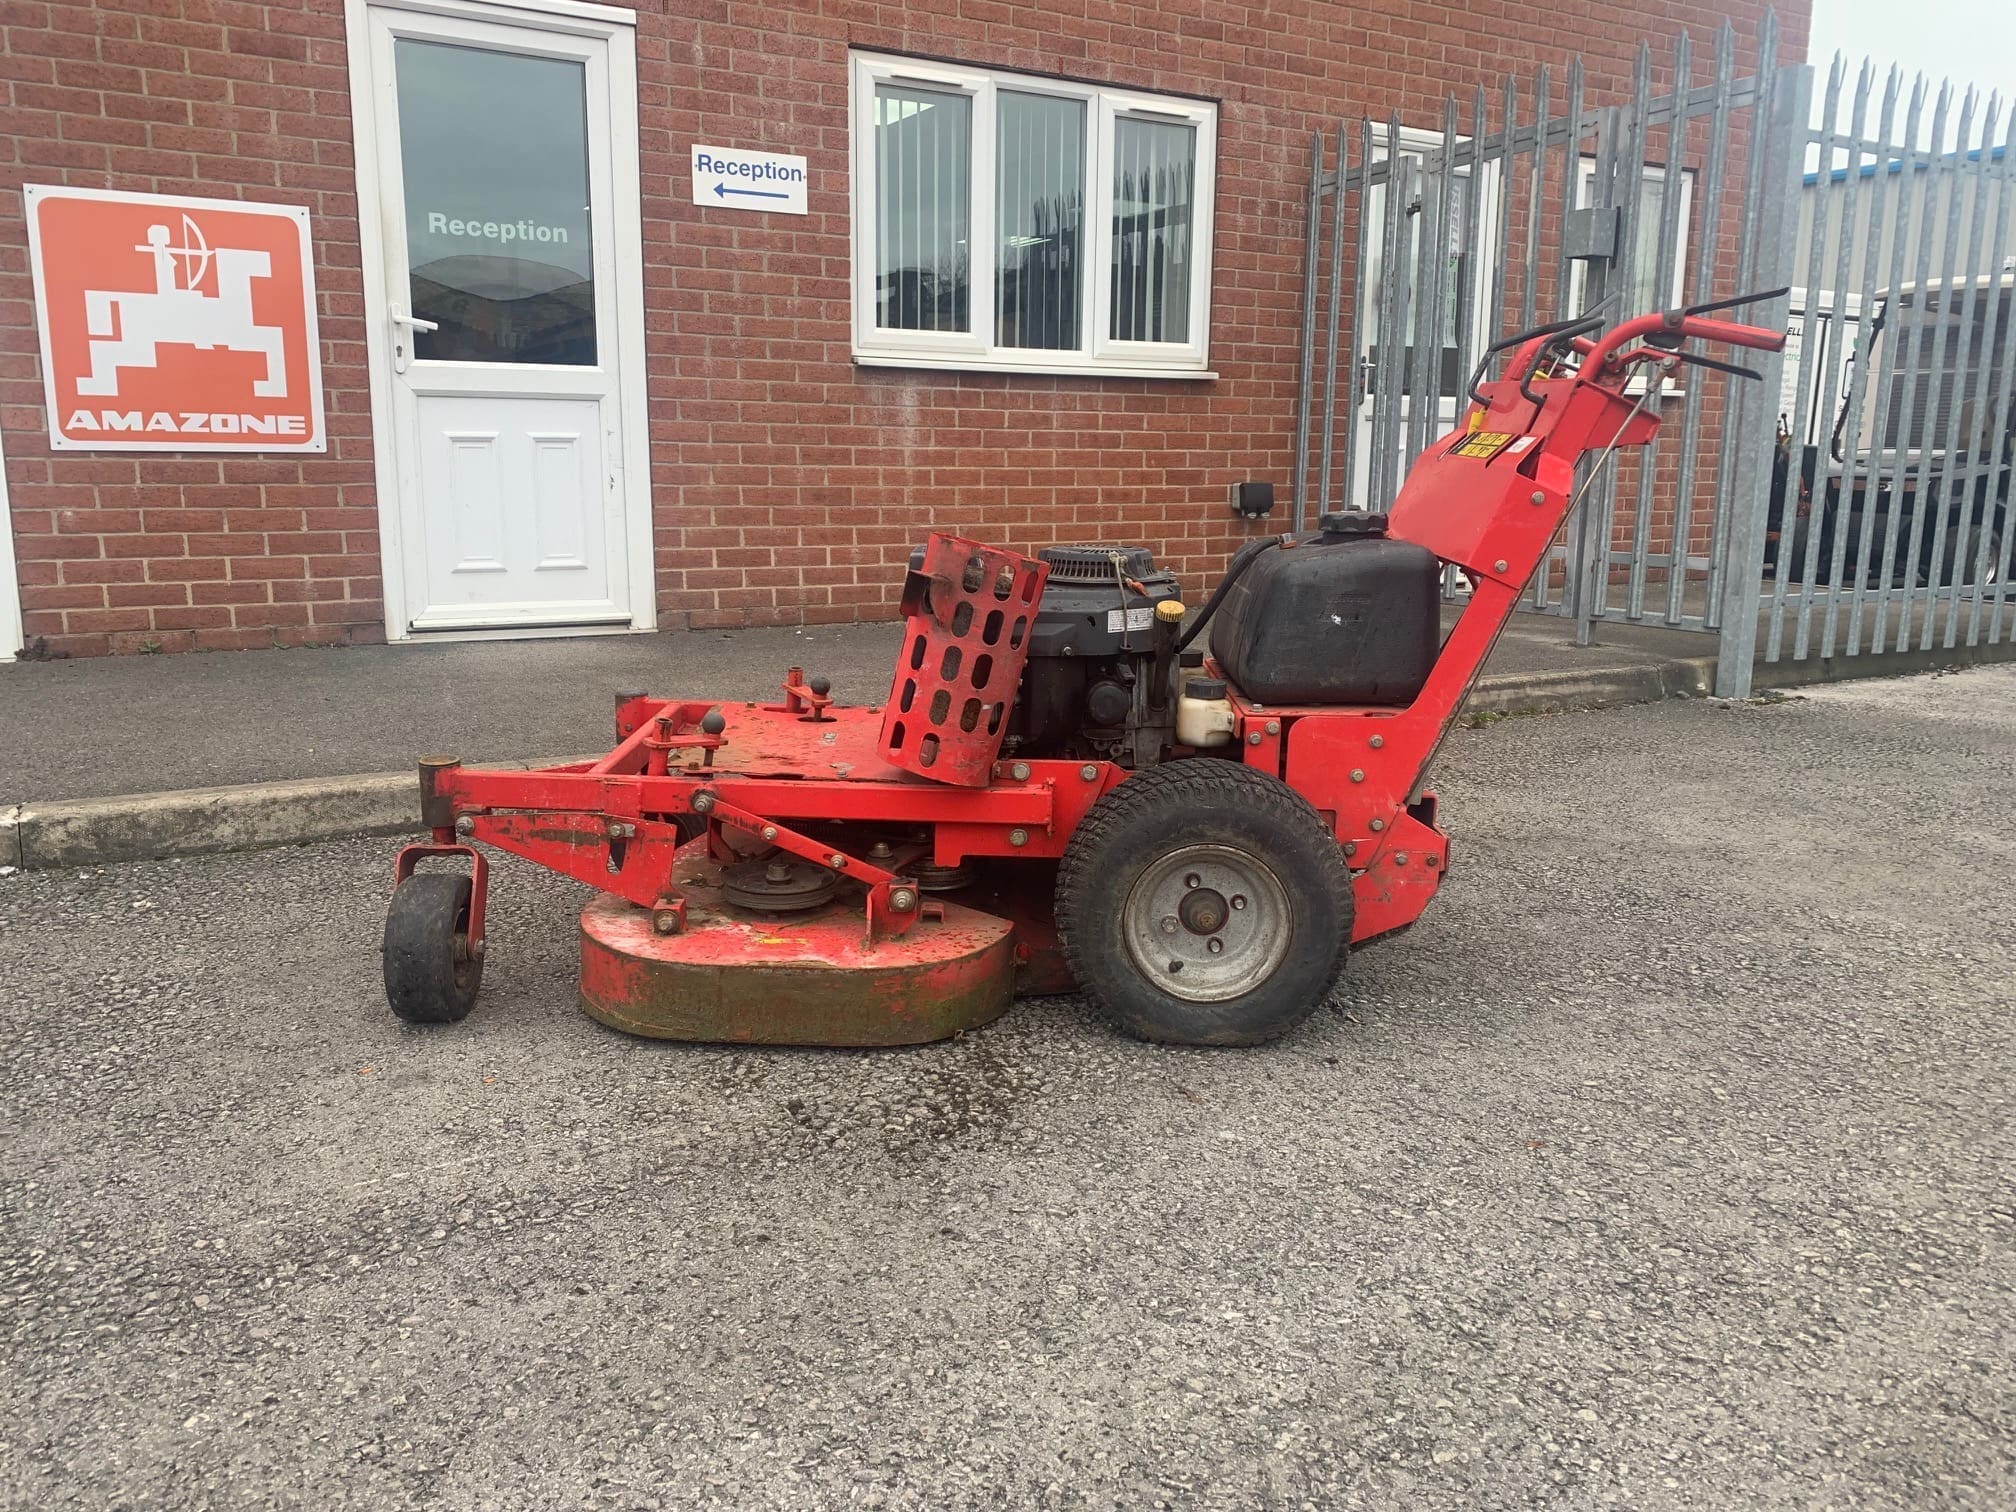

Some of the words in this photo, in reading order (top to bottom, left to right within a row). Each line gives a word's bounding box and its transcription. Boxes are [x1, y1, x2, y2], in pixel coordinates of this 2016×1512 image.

[697, 153, 802, 182] Reception
[428, 211, 568, 244] Reception
[65, 410, 306, 435] AMAZONE
